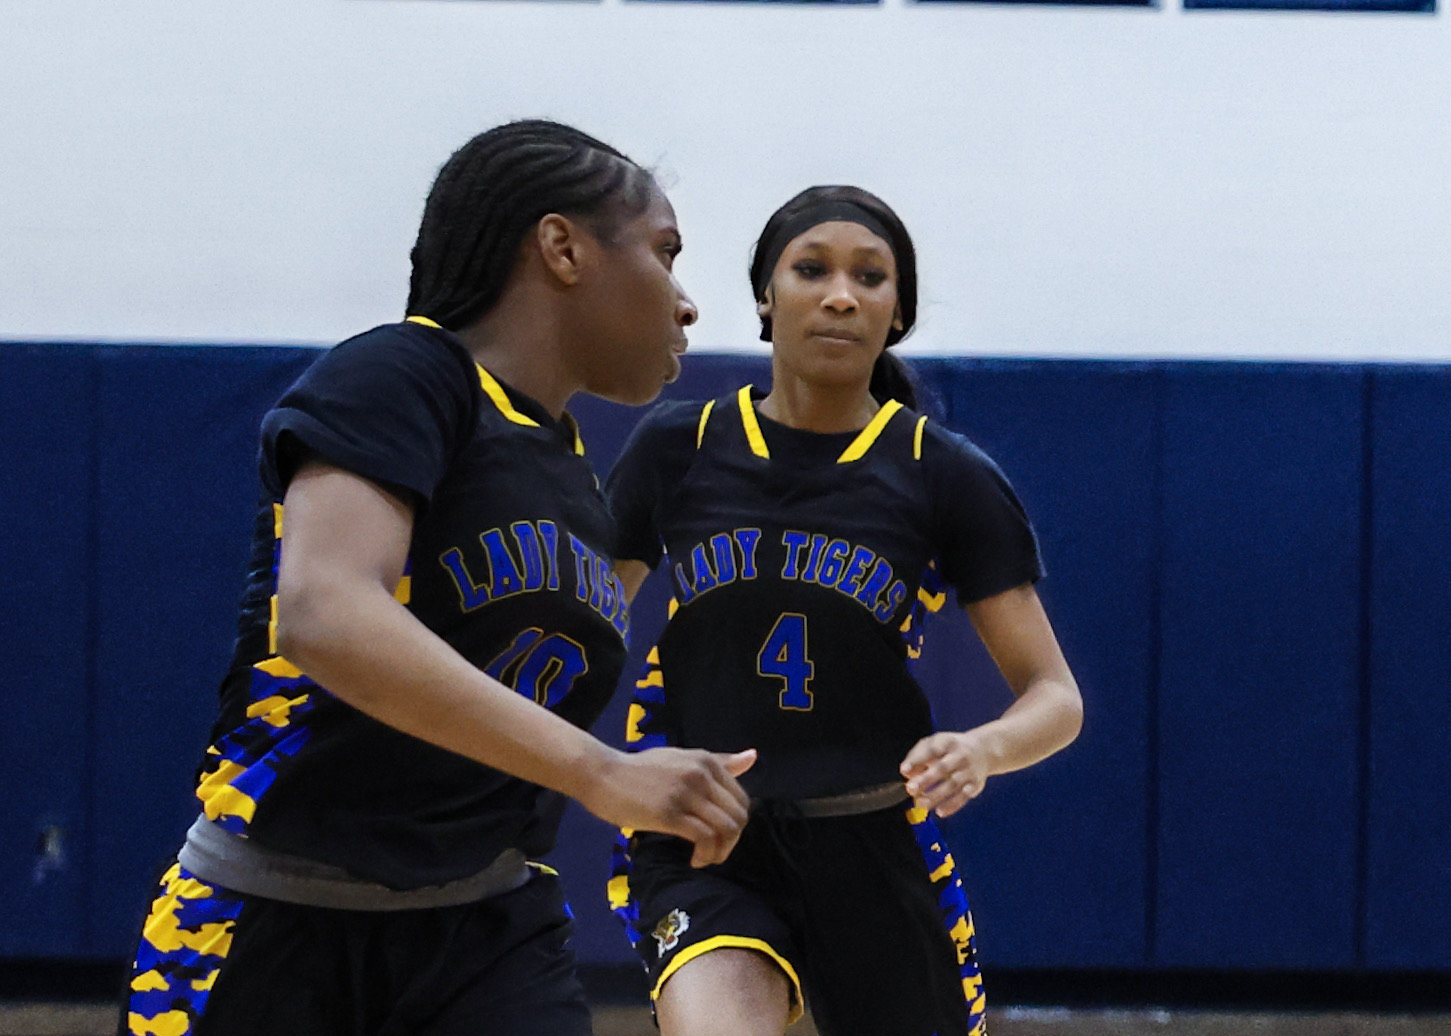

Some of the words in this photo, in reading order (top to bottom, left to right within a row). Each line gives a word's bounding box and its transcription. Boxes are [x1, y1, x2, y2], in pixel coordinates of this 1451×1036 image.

[439, 519, 560, 614] LADY
[567, 531, 631, 652] TIGE
[674, 527, 762, 606] LADY
[782, 529, 908, 625] TIGERS
[757, 611, 815, 712] 4
